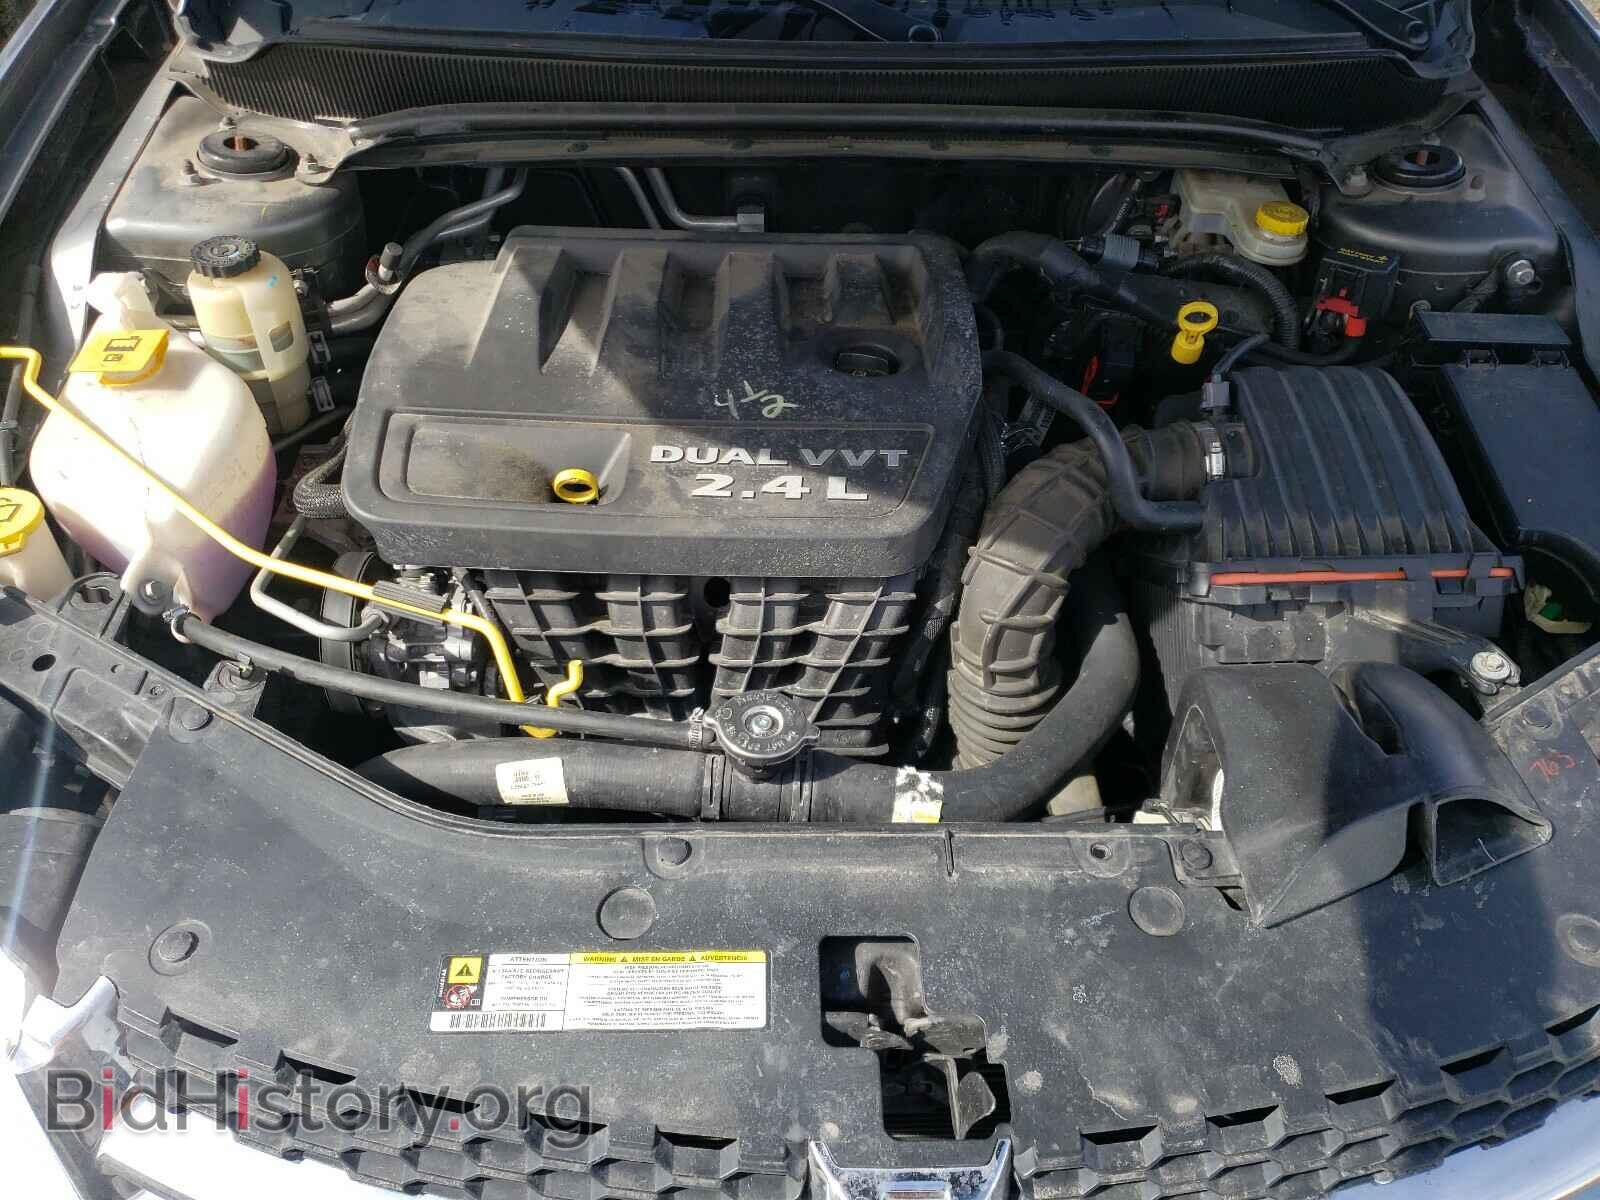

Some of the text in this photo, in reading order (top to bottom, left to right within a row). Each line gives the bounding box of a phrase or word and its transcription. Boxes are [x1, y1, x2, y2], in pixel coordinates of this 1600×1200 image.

[649, 445, 909, 467] DUAL VVT
[583, 955, 617, 963] WARNING
[701, 954, 748, 962] ADVERTENCIA
